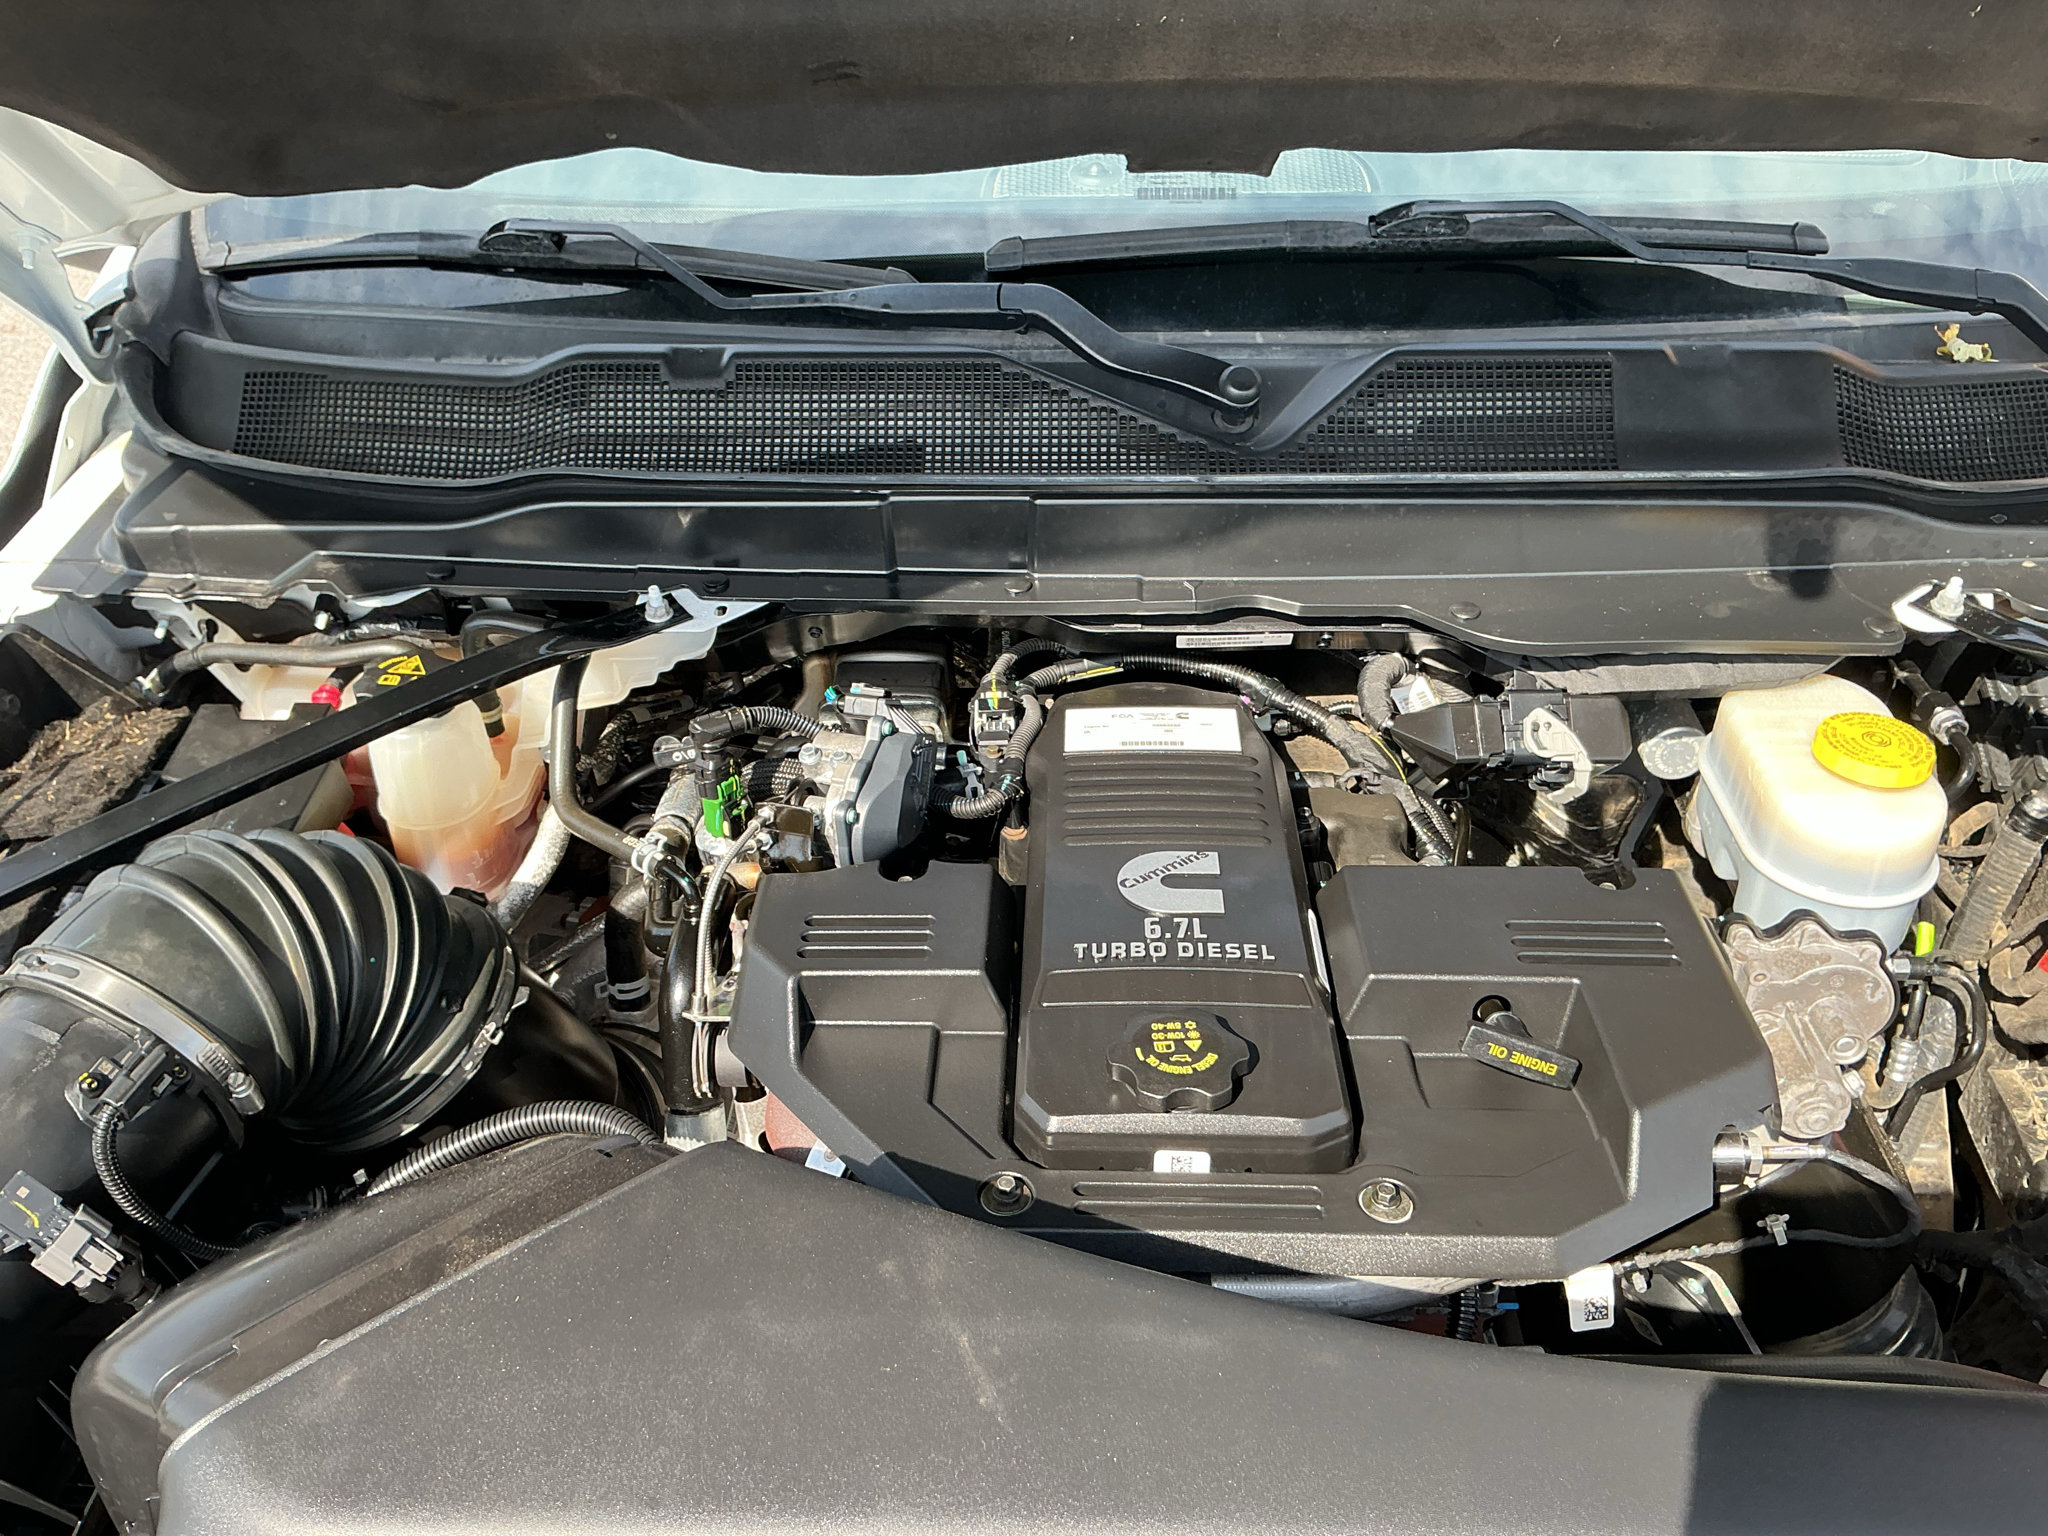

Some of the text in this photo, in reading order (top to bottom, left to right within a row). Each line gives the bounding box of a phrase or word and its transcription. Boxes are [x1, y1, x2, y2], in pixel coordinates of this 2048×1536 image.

[1119, 851, 1210, 889] Cummins
[1143, 917, 1208, 939] 6.7L
[1073, 941, 1277, 960] TURBO DIESEL
[1151, 1022, 1182, 1030] 5W-40
[1151, 1031, 1186, 1040] 10W-30
[1145, 1052, 1218, 1074] DIESEL ENGINE OIL
[1487, 1042, 1559, 1076] ENGINE OIL
